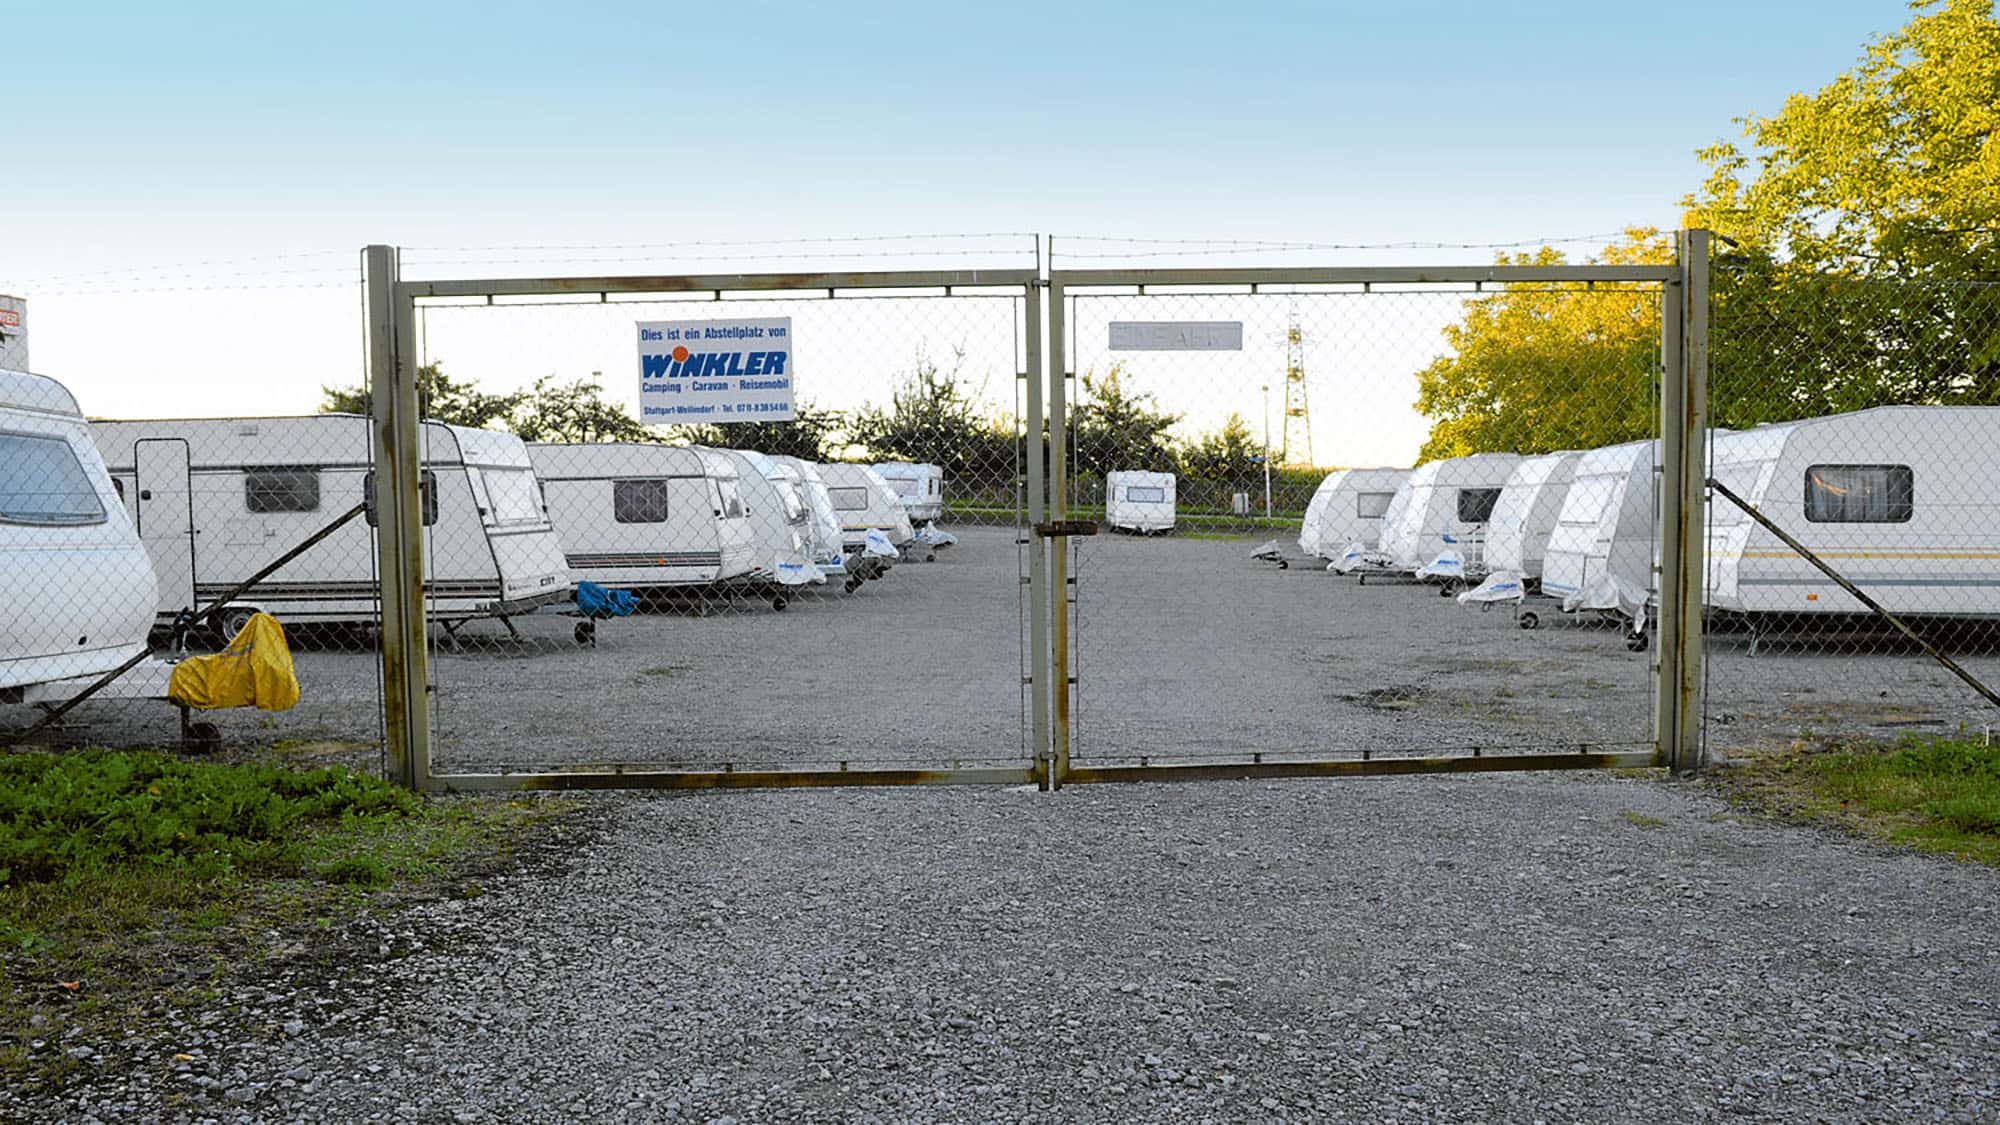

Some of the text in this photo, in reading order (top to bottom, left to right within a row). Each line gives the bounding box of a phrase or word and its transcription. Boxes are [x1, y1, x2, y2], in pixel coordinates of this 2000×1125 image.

[641, 326, 786, 341] Dies ist ein Abstellplatz von
[642, 346, 787, 378] WINKLER
[642, 379, 789, 394] Camping Caravan Reisemobil
